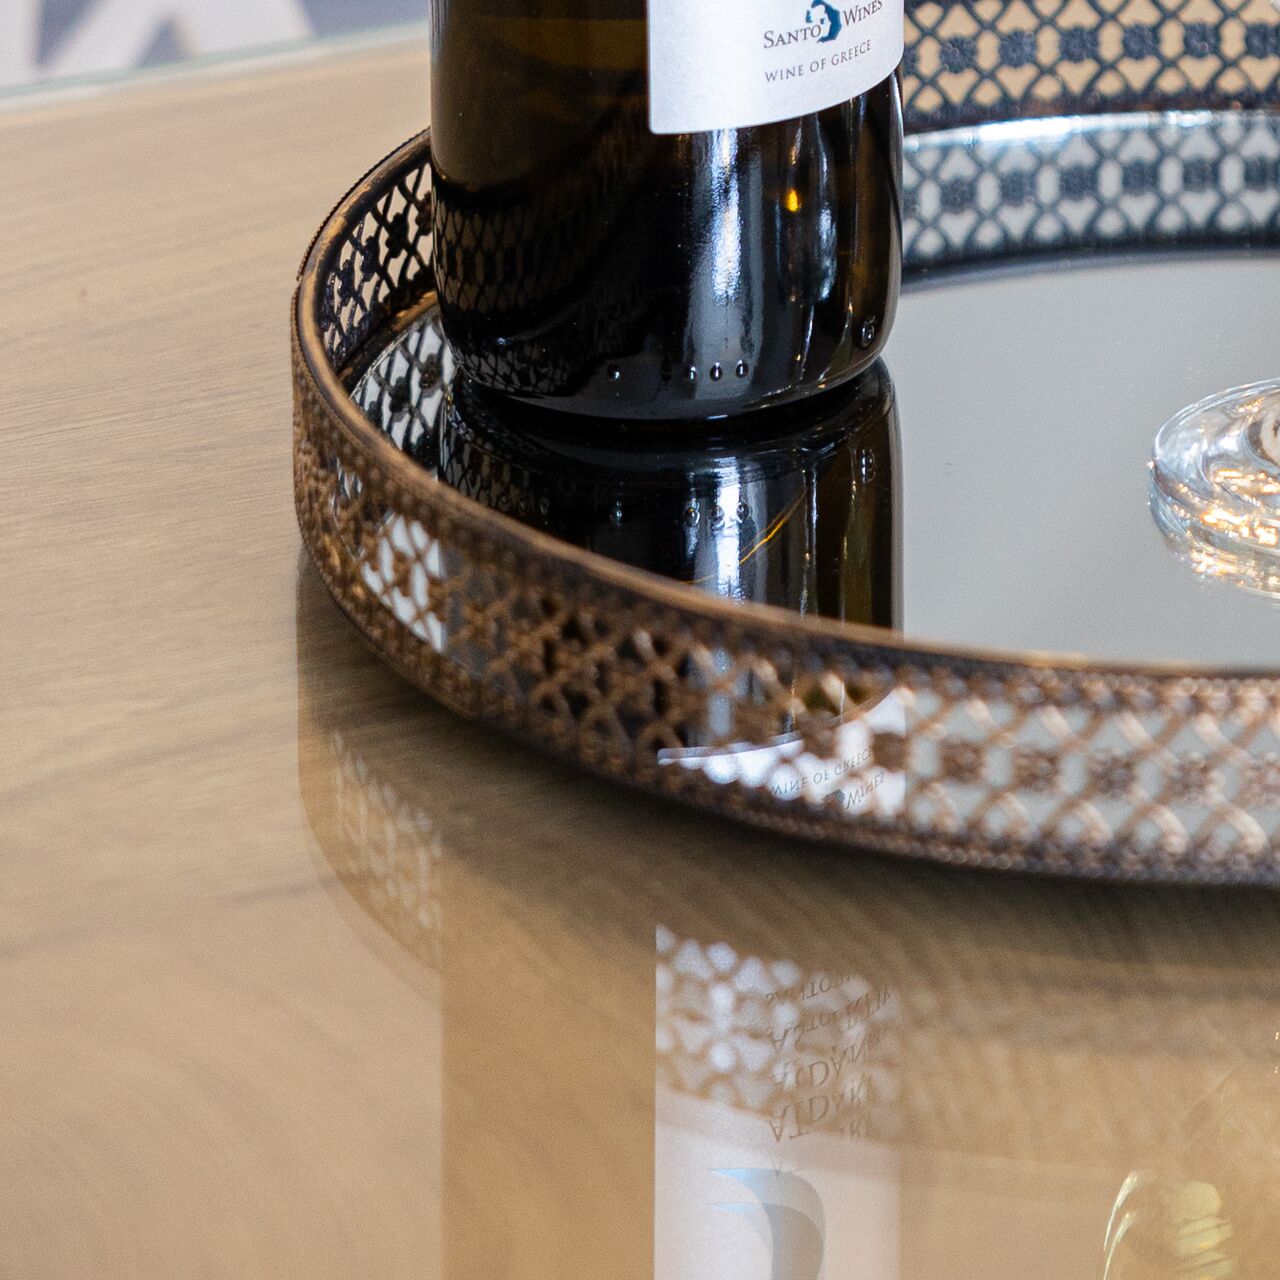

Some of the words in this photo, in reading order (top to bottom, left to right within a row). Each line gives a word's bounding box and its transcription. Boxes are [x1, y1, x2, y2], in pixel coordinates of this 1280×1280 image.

[765, 64, 804, 83] WINE
[809, 57, 827, 73] OF
[831, 39, 872, 66] GREECE
